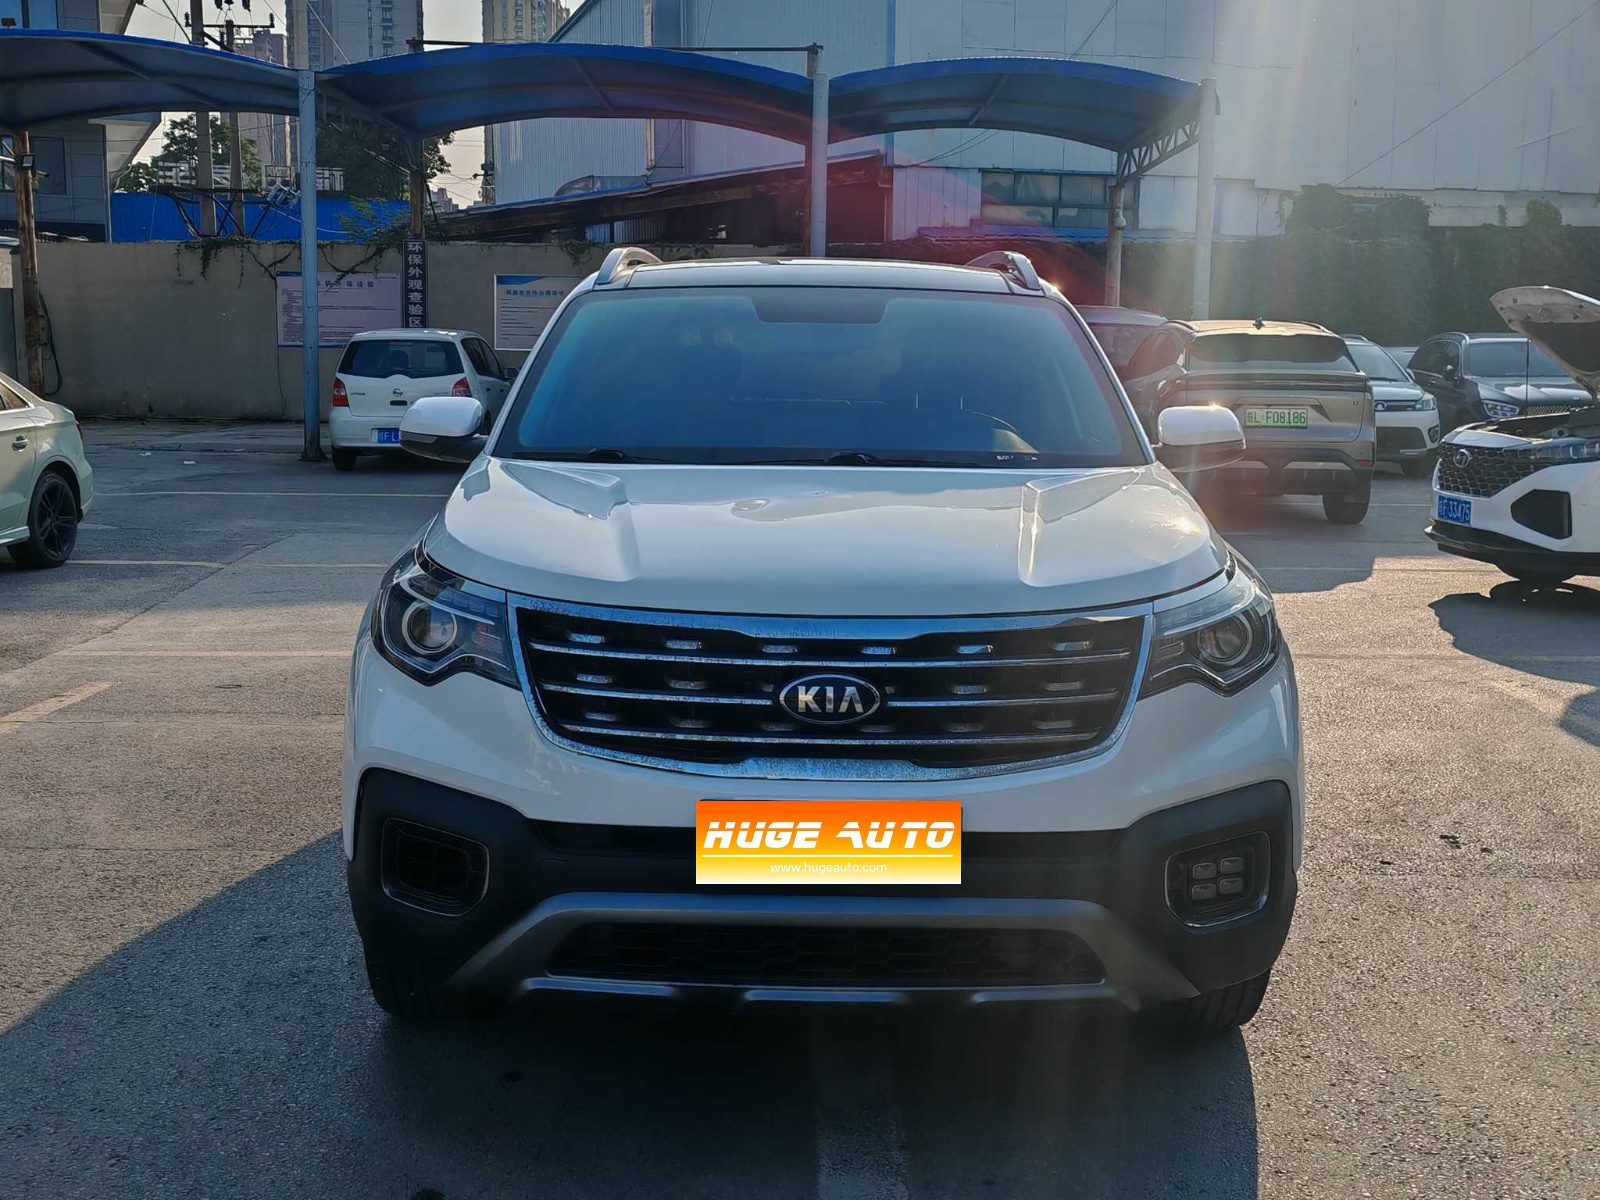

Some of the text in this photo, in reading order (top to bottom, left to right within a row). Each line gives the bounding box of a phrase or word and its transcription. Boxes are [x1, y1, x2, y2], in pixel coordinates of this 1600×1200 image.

[406, 241, 424, 328] 环保外观查验区
[1265, 411, 1306, 424] F08186
[797, 685, 864, 713] KIA
